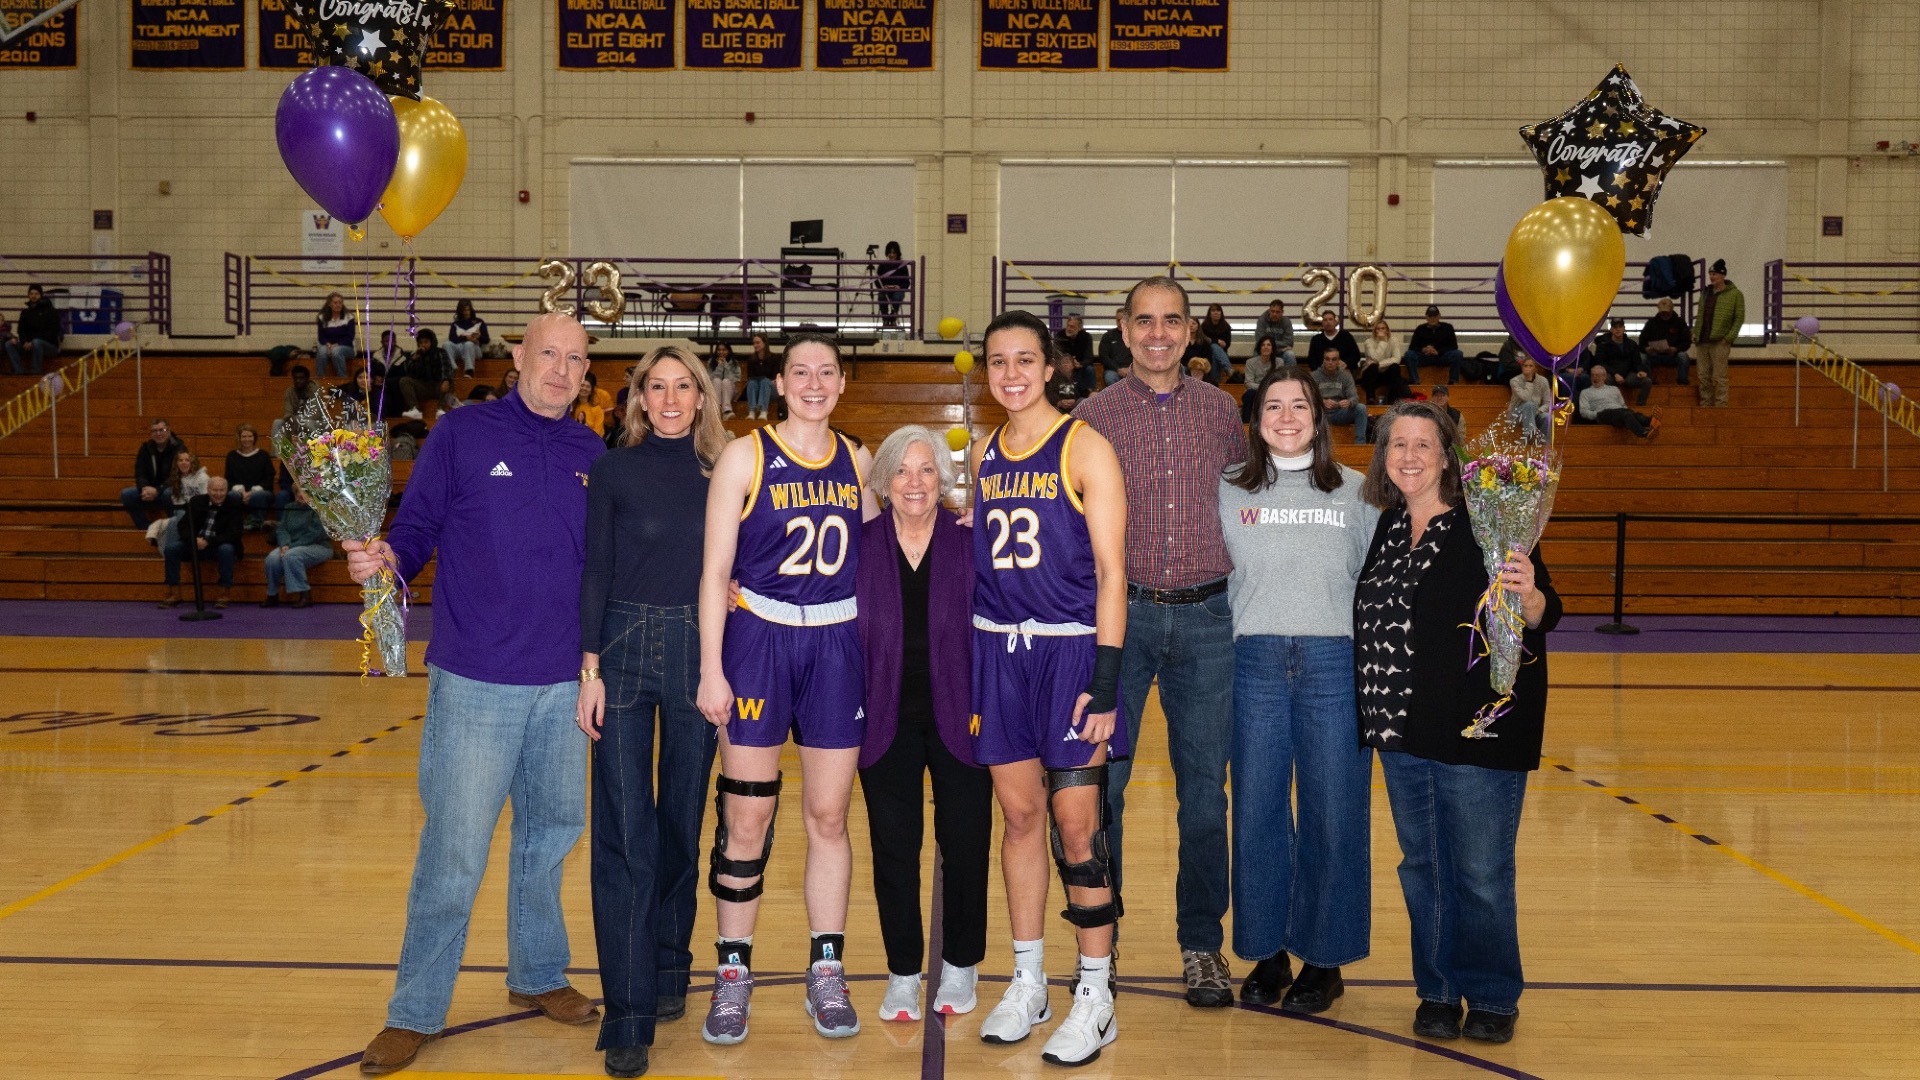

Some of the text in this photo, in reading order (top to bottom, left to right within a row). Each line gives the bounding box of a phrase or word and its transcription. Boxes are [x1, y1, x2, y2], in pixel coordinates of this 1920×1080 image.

[166, 9, 209, 21] NCAA
[319, 0, 422, 27] Congrats!
[586, 13, 646, 29] NCAA
[713, 13, 775, 29] NCAA
[843, 10, 907, 25] NCAA
[1008, 13, 1072, 30] NCAA
[1144, 9, 1193, 21] NCAA
[137, 25, 240, 36] TOURNAMENT
[820, 27, 930, 42] SWEET SIXTEEN
[1115, 25, 1223, 37] TOURNAMENT
[449, 33, 494, 48] FOUR
[567, 32, 666, 48] ELITE EIGHT
[702, 32, 786, 48] ELITE EIGHT
[983, 32, 1097, 49] SWEET SIXTEEN
[1112, 40, 1179, 50] 1994 1995 2015
[0, 50, 41, 62] 2010
[425, 51, 465, 63] 2013
[597, 51, 637, 63] 2014
[723, 51, 763, 63] 2019
[852, 44, 897, 56] 2020
[1017, 51, 1063, 64] 2022
[1547, 135, 1657, 169] Congrats!
[539, 260, 626, 324] 23
[1301, 265, 1388, 329] 20
[980, 472, 1059, 502] WILLIAMS
[769, 480, 859, 511] WILLIAMS
[778, 515, 849, 576] 20
[986, 507, 1042, 570] 23
[736, 697, 765, 720] W
